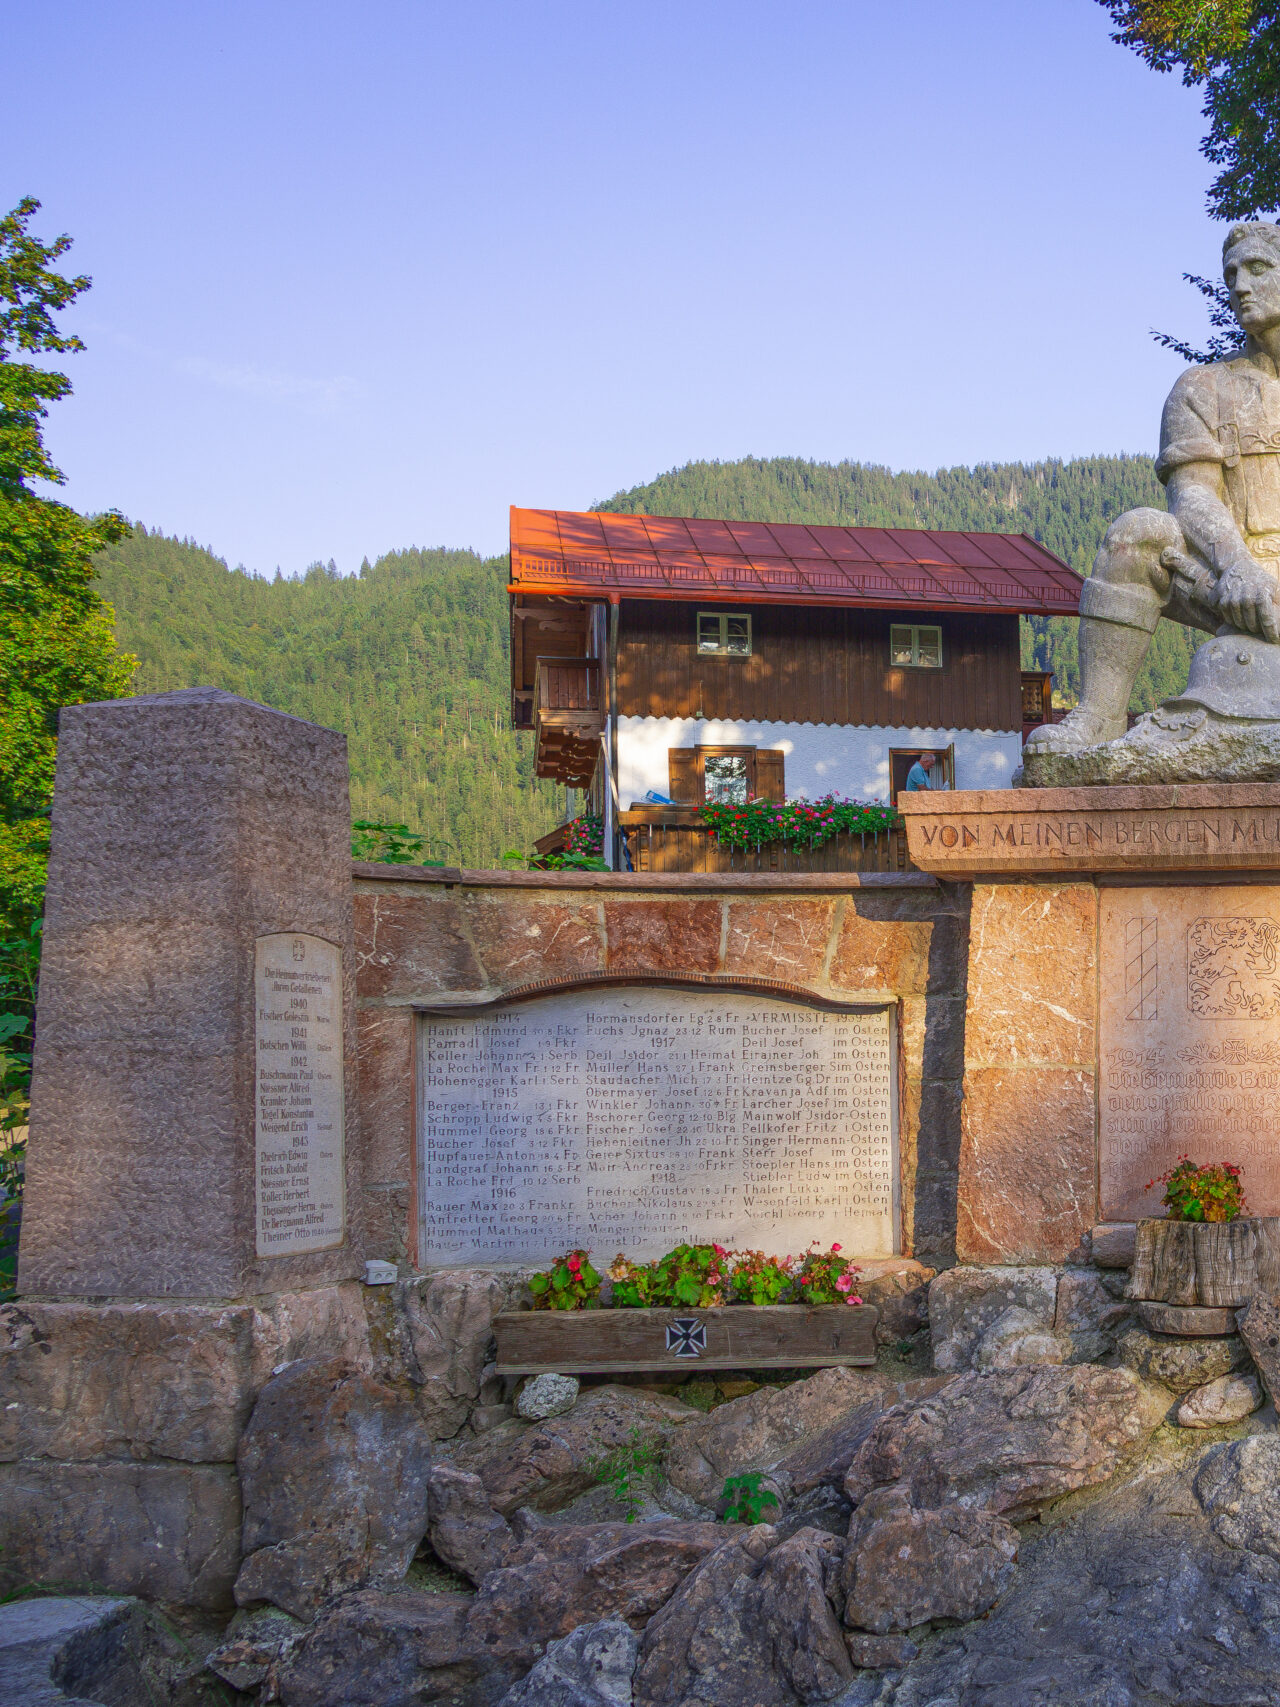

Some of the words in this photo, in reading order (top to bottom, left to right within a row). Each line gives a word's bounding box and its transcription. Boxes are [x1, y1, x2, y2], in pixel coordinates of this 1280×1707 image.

[921, 825, 980, 847] VON
[992, 823, 1103, 847] MEINEN
[1115, 820, 1220, 844] BERGEN
[291, 999, 307, 1009] 1940
[494, 1014, 520, 1023] 1914
[753, 1013, 829, 1023] VERMISSTE
[291, 1028, 307, 1038] 1941
[475, 1026, 527, 1036] Edmund
[587, 1025, 624, 1035] Fuchs
[651, 1038, 675, 1047] 1917
[743, 1038, 766, 1047] Deil
[771, 1038, 804, 1047] Josef
[852, 1037, 888, 1046] Osten
[428, 1051, 468, 1061] Keller
[476, 1051, 522, 1061] Johann
[852, 1049, 886, 1058] Osten
[291, 1057, 307, 1066] 1942
[428, 1064, 442, 1073] La
[448, 1063, 486, 1073] Roche
[492, 1063, 519, 1072] Max
[428, 1076, 505, 1088] Hohenegger
[511, 1075, 538, 1085] Karl
[586, 1075, 660, 1085] Staudacher
[493, 1088, 518, 1098] 1915
[586, 1087, 657, 1099] Obermayer
[665, 1087, 698, 1097] Josef
[743, 1087, 800, 1098] Kravanja
[853, 1086, 888, 1095] Osten
[428, 1101, 471, 1113] Berger
[482, 1101, 518, 1110] Franz
[587, 1100, 638, 1109] Winkler
[743, 1099, 792, 1108] Larcher
[853, 1098, 887, 1107] Osten
[428, 1114, 480, 1126] Schropp
[486, 1113, 532, 1124] Ludwig
[587, 1112, 642, 1122] Bschorer
[648, 1112, 685, 1124] Georg
[743, 1111, 801, 1121] Mainwolf
[428, 1126, 482, 1136] Hummel
[490, 1126, 527, 1137] Georg
[587, 1124, 633, 1134] Fischer
[639, 1124, 672, 1134] Josef
[743, 1123, 800, 1133] Pellkofer
[806, 1123, 837, 1132] Fritz
[852, 1122, 888, 1131] Osten
[292, 1137, 308, 1147] 1943
[428, 1139, 473, 1149] Bucher
[482, 1138, 516, 1148] Josef
[743, 1136, 782, 1147] Singer
[700, 1149, 734, 1157] Frank
[743, 1147, 775, 1157] Sterr
[783, 1147, 814, 1156] Josef
[743, 1160, 794, 1170] Stoepler
[800, 1159, 830, 1168] Hans
[428, 1164, 487, 1176] Landgraf
[492, 1164, 538, 1172] Johann
[743, 1172, 793, 1181] Stiebler
[491, 1188, 516, 1198] 1916
[744, 1184, 784, 1194] Thaler
[428, 1201, 465, 1211] Bauer
[471, 1201, 497, 1211] Max
[295, 1228, 310, 1238] Otto
